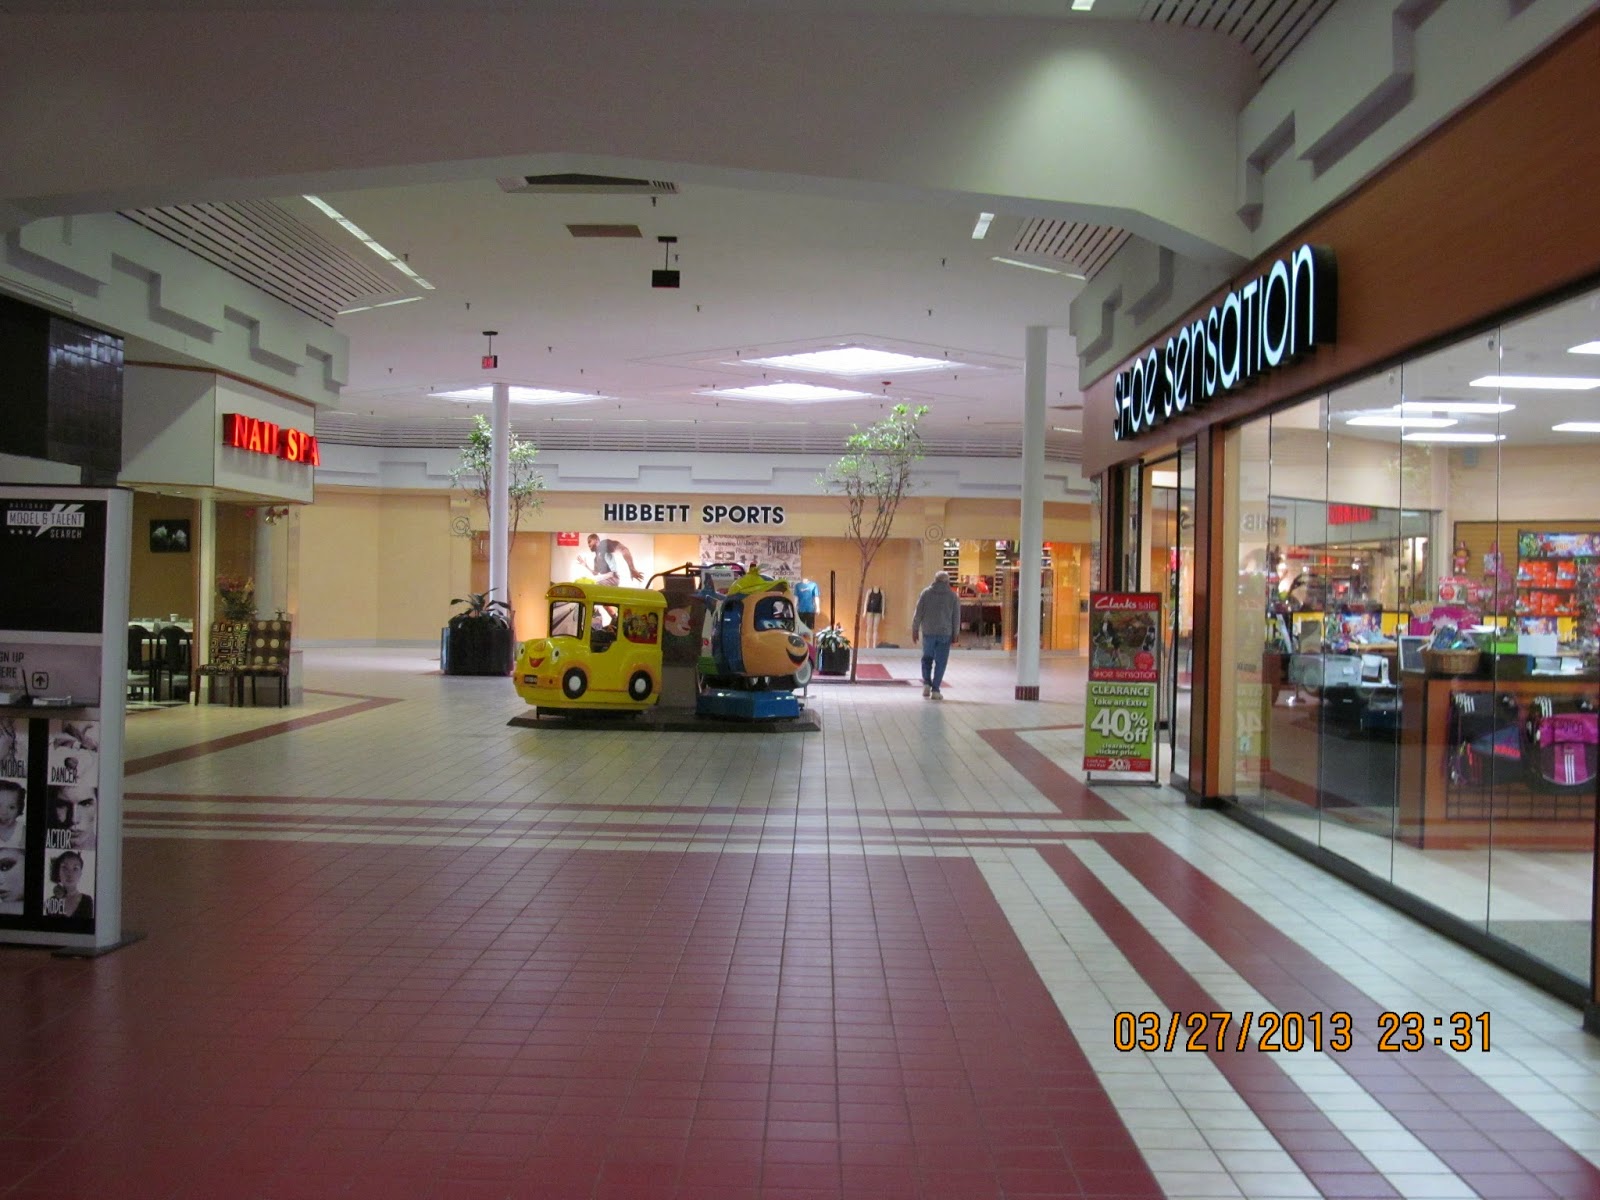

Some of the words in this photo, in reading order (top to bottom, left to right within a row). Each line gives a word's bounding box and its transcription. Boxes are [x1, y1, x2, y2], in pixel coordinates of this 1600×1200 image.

[286, 427, 320, 466] SPA
[10, 511, 40, 525] MODEL
[51, 512, 82, 526] TALENT
[603, 503, 690, 522] HIBBETT
[702, 505, 784, 524] SPORTS
[50, 528, 82, 539] SEARCH
[1095, 596, 1137, 609] Clarks
[1138, 600, 1157, 609] sale
[12, 651, 24, 663] UP
[1091, 685, 1150, 697] CLEARANCE
[1093, 697, 1112, 705] Take
[1126, 698, 1147, 707] Extra
[1123, 728, 1148, 743] off
[1, 758, 26, 779] MODEL
[51, 766, 78, 784] DANCER
[45, 828, 72, 849] ACTOR
[44, 897, 67, 914] MODEL
